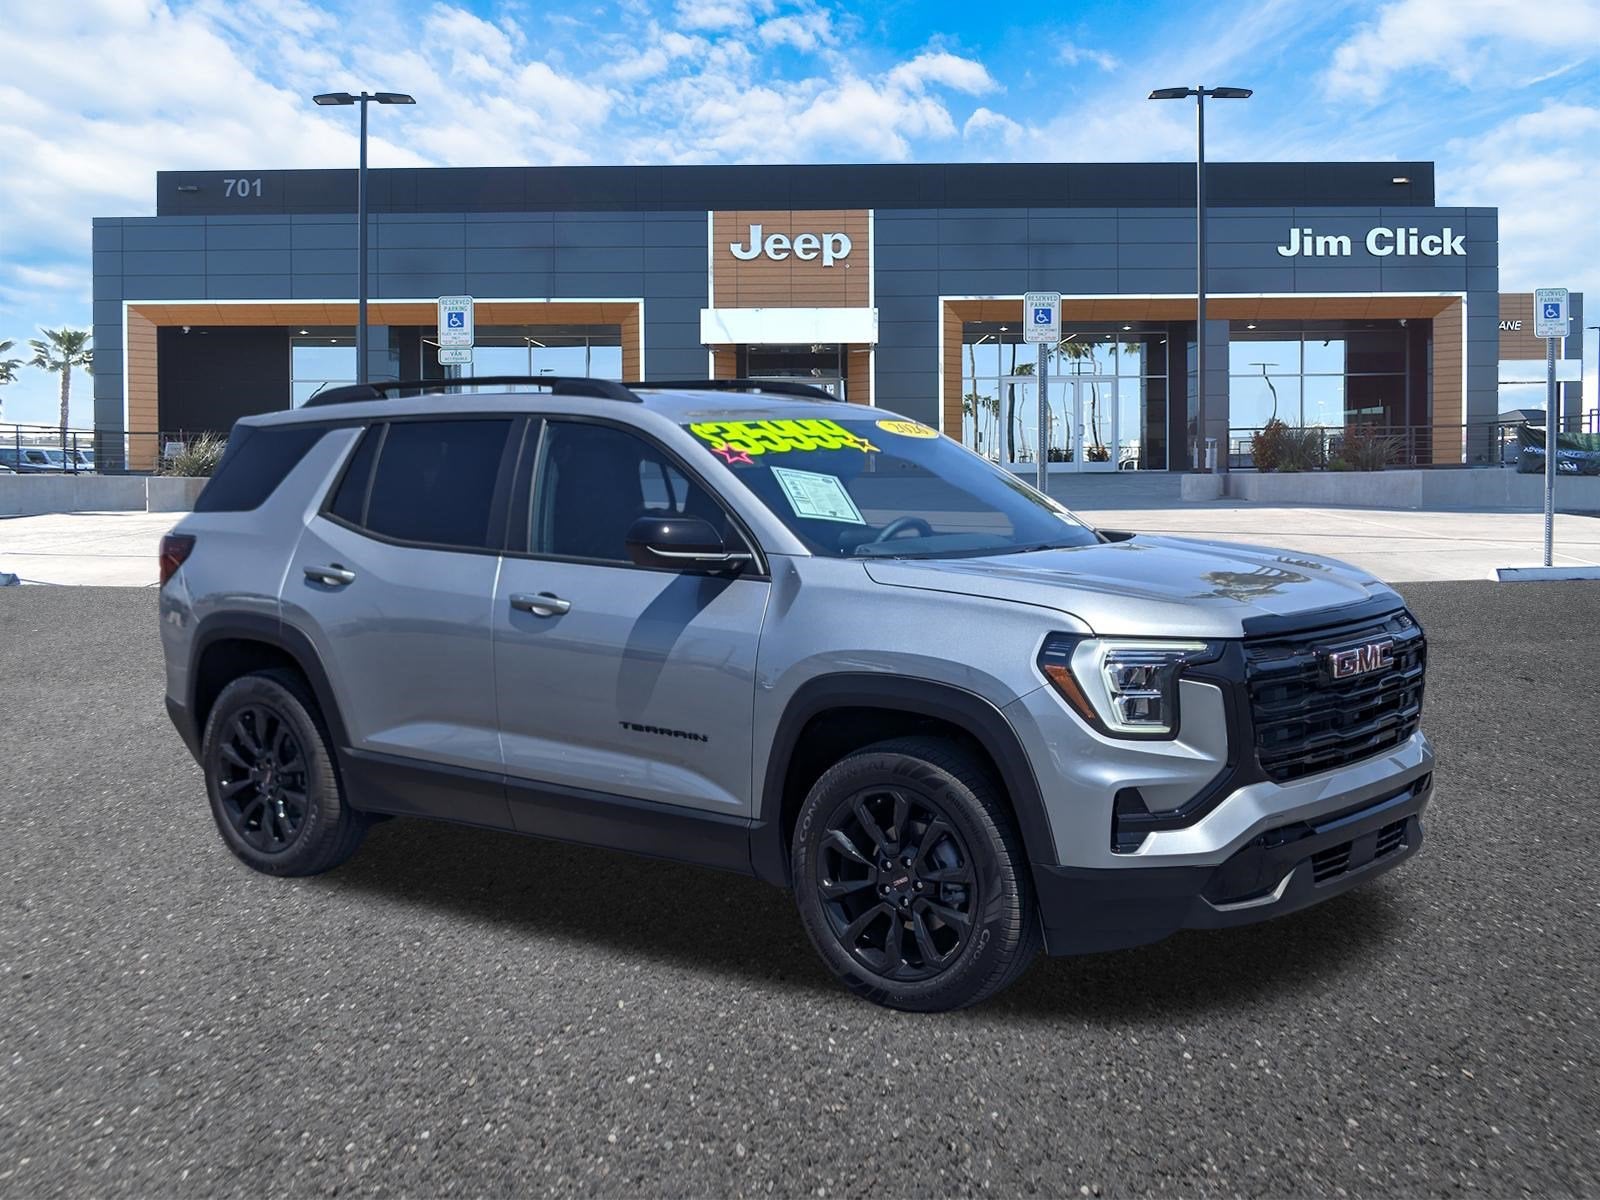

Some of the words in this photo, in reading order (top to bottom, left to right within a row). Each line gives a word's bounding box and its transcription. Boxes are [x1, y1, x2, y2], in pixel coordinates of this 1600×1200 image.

[224, 178, 262, 197] 701
[730, 224, 852, 267] Jeep
[1277, 228, 1352, 257] Jim
[1366, 227, 1467, 256] Click
[1332, 639, 1394, 679] GMC
[619, 720, 708, 742] TERRAIN
